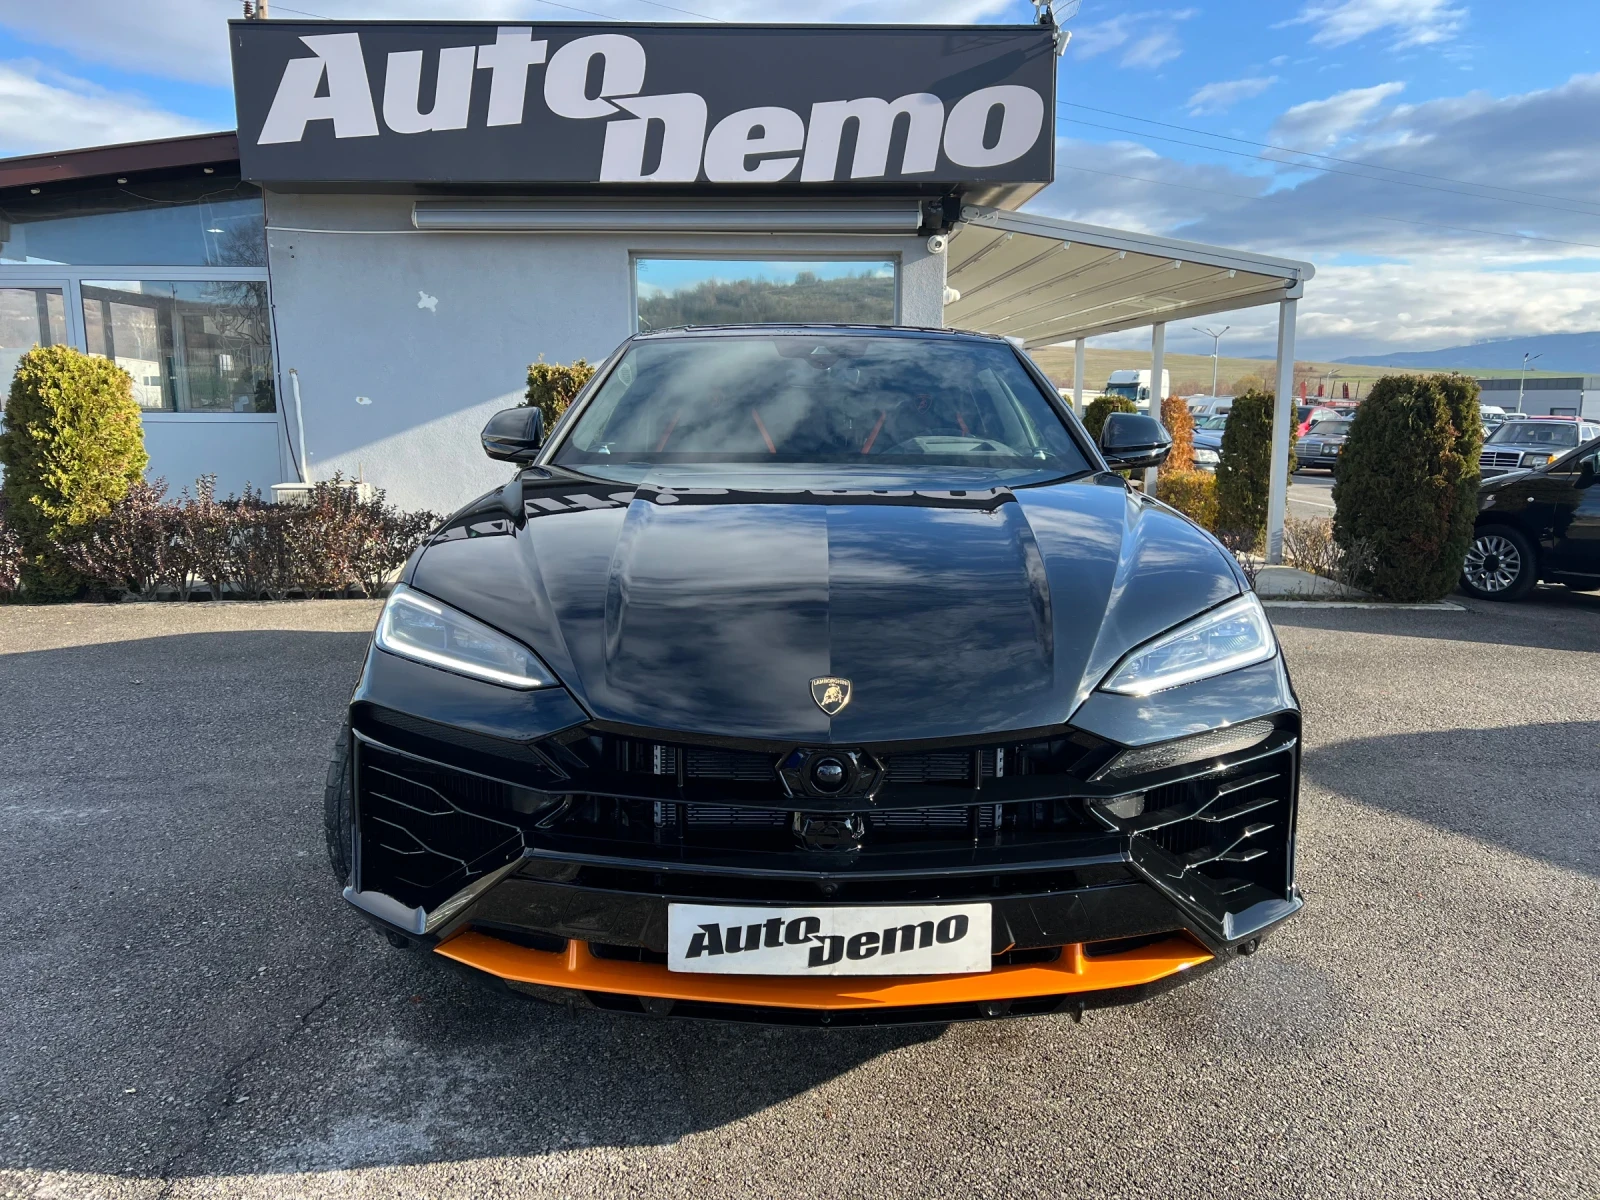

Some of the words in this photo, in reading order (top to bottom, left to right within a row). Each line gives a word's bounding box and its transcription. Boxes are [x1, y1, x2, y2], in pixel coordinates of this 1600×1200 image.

[257, 27, 647, 145] Auto
[600, 85, 1044, 183] Demo
[685, 916, 821, 959] Auto
[808, 914, 969, 968] Demo
